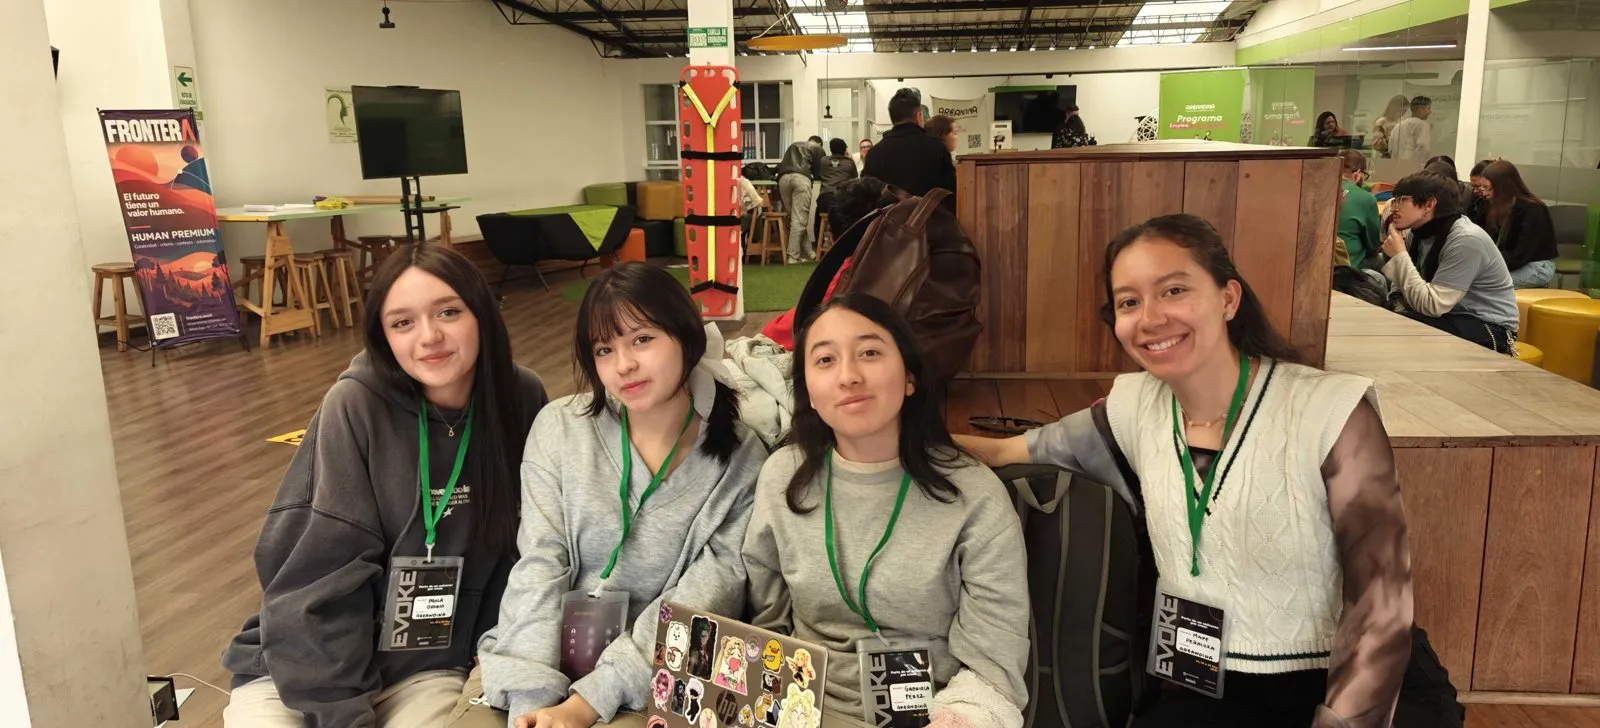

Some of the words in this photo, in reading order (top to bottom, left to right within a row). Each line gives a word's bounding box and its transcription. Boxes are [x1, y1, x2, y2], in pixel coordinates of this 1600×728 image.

[1177, 115, 1222, 124] Programa
[123, 193, 131, 201] El
[150, 208, 185, 216] humano.
[131, 231, 169, 242] HUMAN
[171, 228, 215, 238] PREMIUM
[390, 570, 417, 647] EVOKE
[1155, 594, 1178, 677] EVOKE
[868, 653, 893, 728] VOKE
[719, 690, 737, 724] hp
